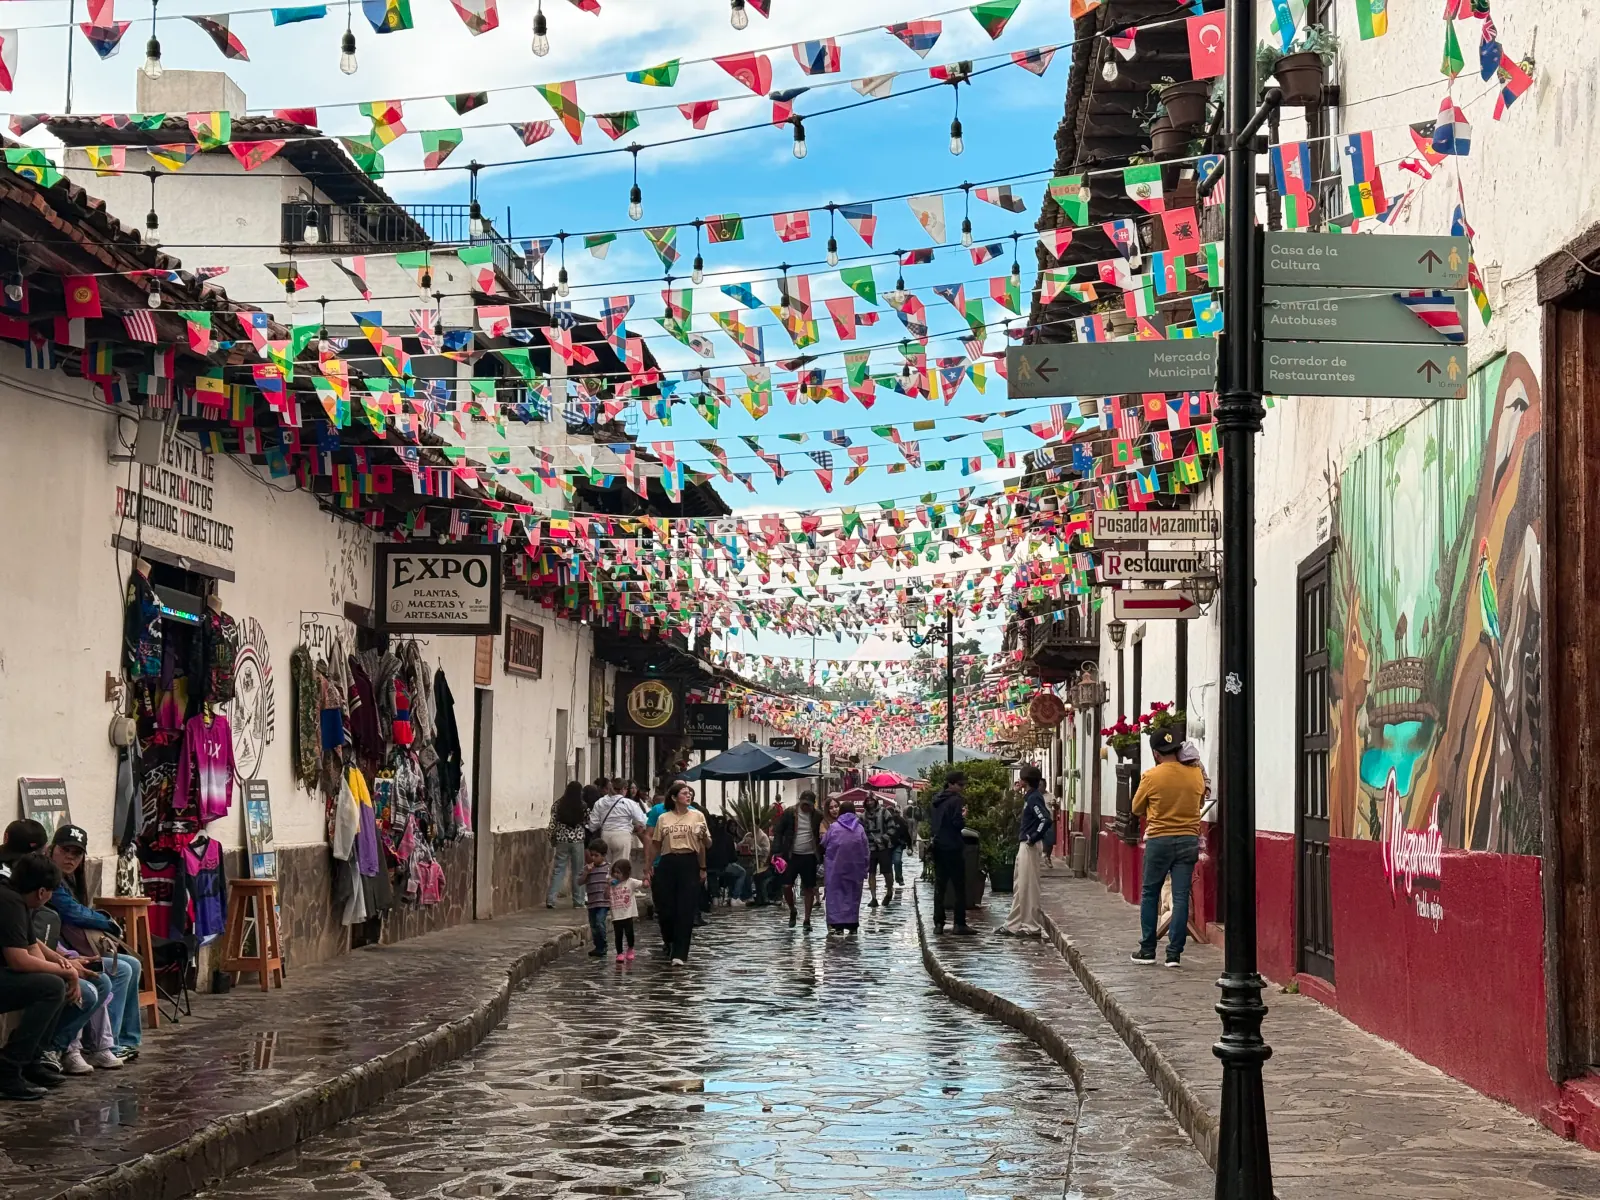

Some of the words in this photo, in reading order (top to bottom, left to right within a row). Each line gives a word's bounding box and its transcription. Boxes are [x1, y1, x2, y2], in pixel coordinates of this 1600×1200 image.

[1271, 244, 1304, 255] Casa
[1307, 244, 1323, 256] de
[1325, 245, 1338, 256] la
[1270, 259, 1321, 270] Cultura
[1271, 299, 1320, 311] Central
[1322, 299, 1339, 311] de
[1270, 314, 1338, 326] Autobuses
[1153, 350, 1211, 363] Mercado
[1269, 355, 1329, 366] Corredor
[1330, 356, 1347, 367] de
[1148, 365, 1212, 379] Municipal
[1269, 369, 1356, 382] Restaurantes
[201, 455, 215, 483] DE
[143, 465, 214, 513] CUATRIMOTOS
[115, 485, 179, 535] RECRRIDOS
[180, 508, 234, 552] TURISTICOS
[1097, 516, 1148, 536] Posada
[1149, 516, 1219, 536] Mazamitla
[392, 557, 488, 589] EXPO
[413, 589, 460, 598] PLANTAS,
[407, 600, 455, 609] MACETAS
[458, 601, 466, 609] Y
[404, 611, 468, 620] ARTESANIAS
